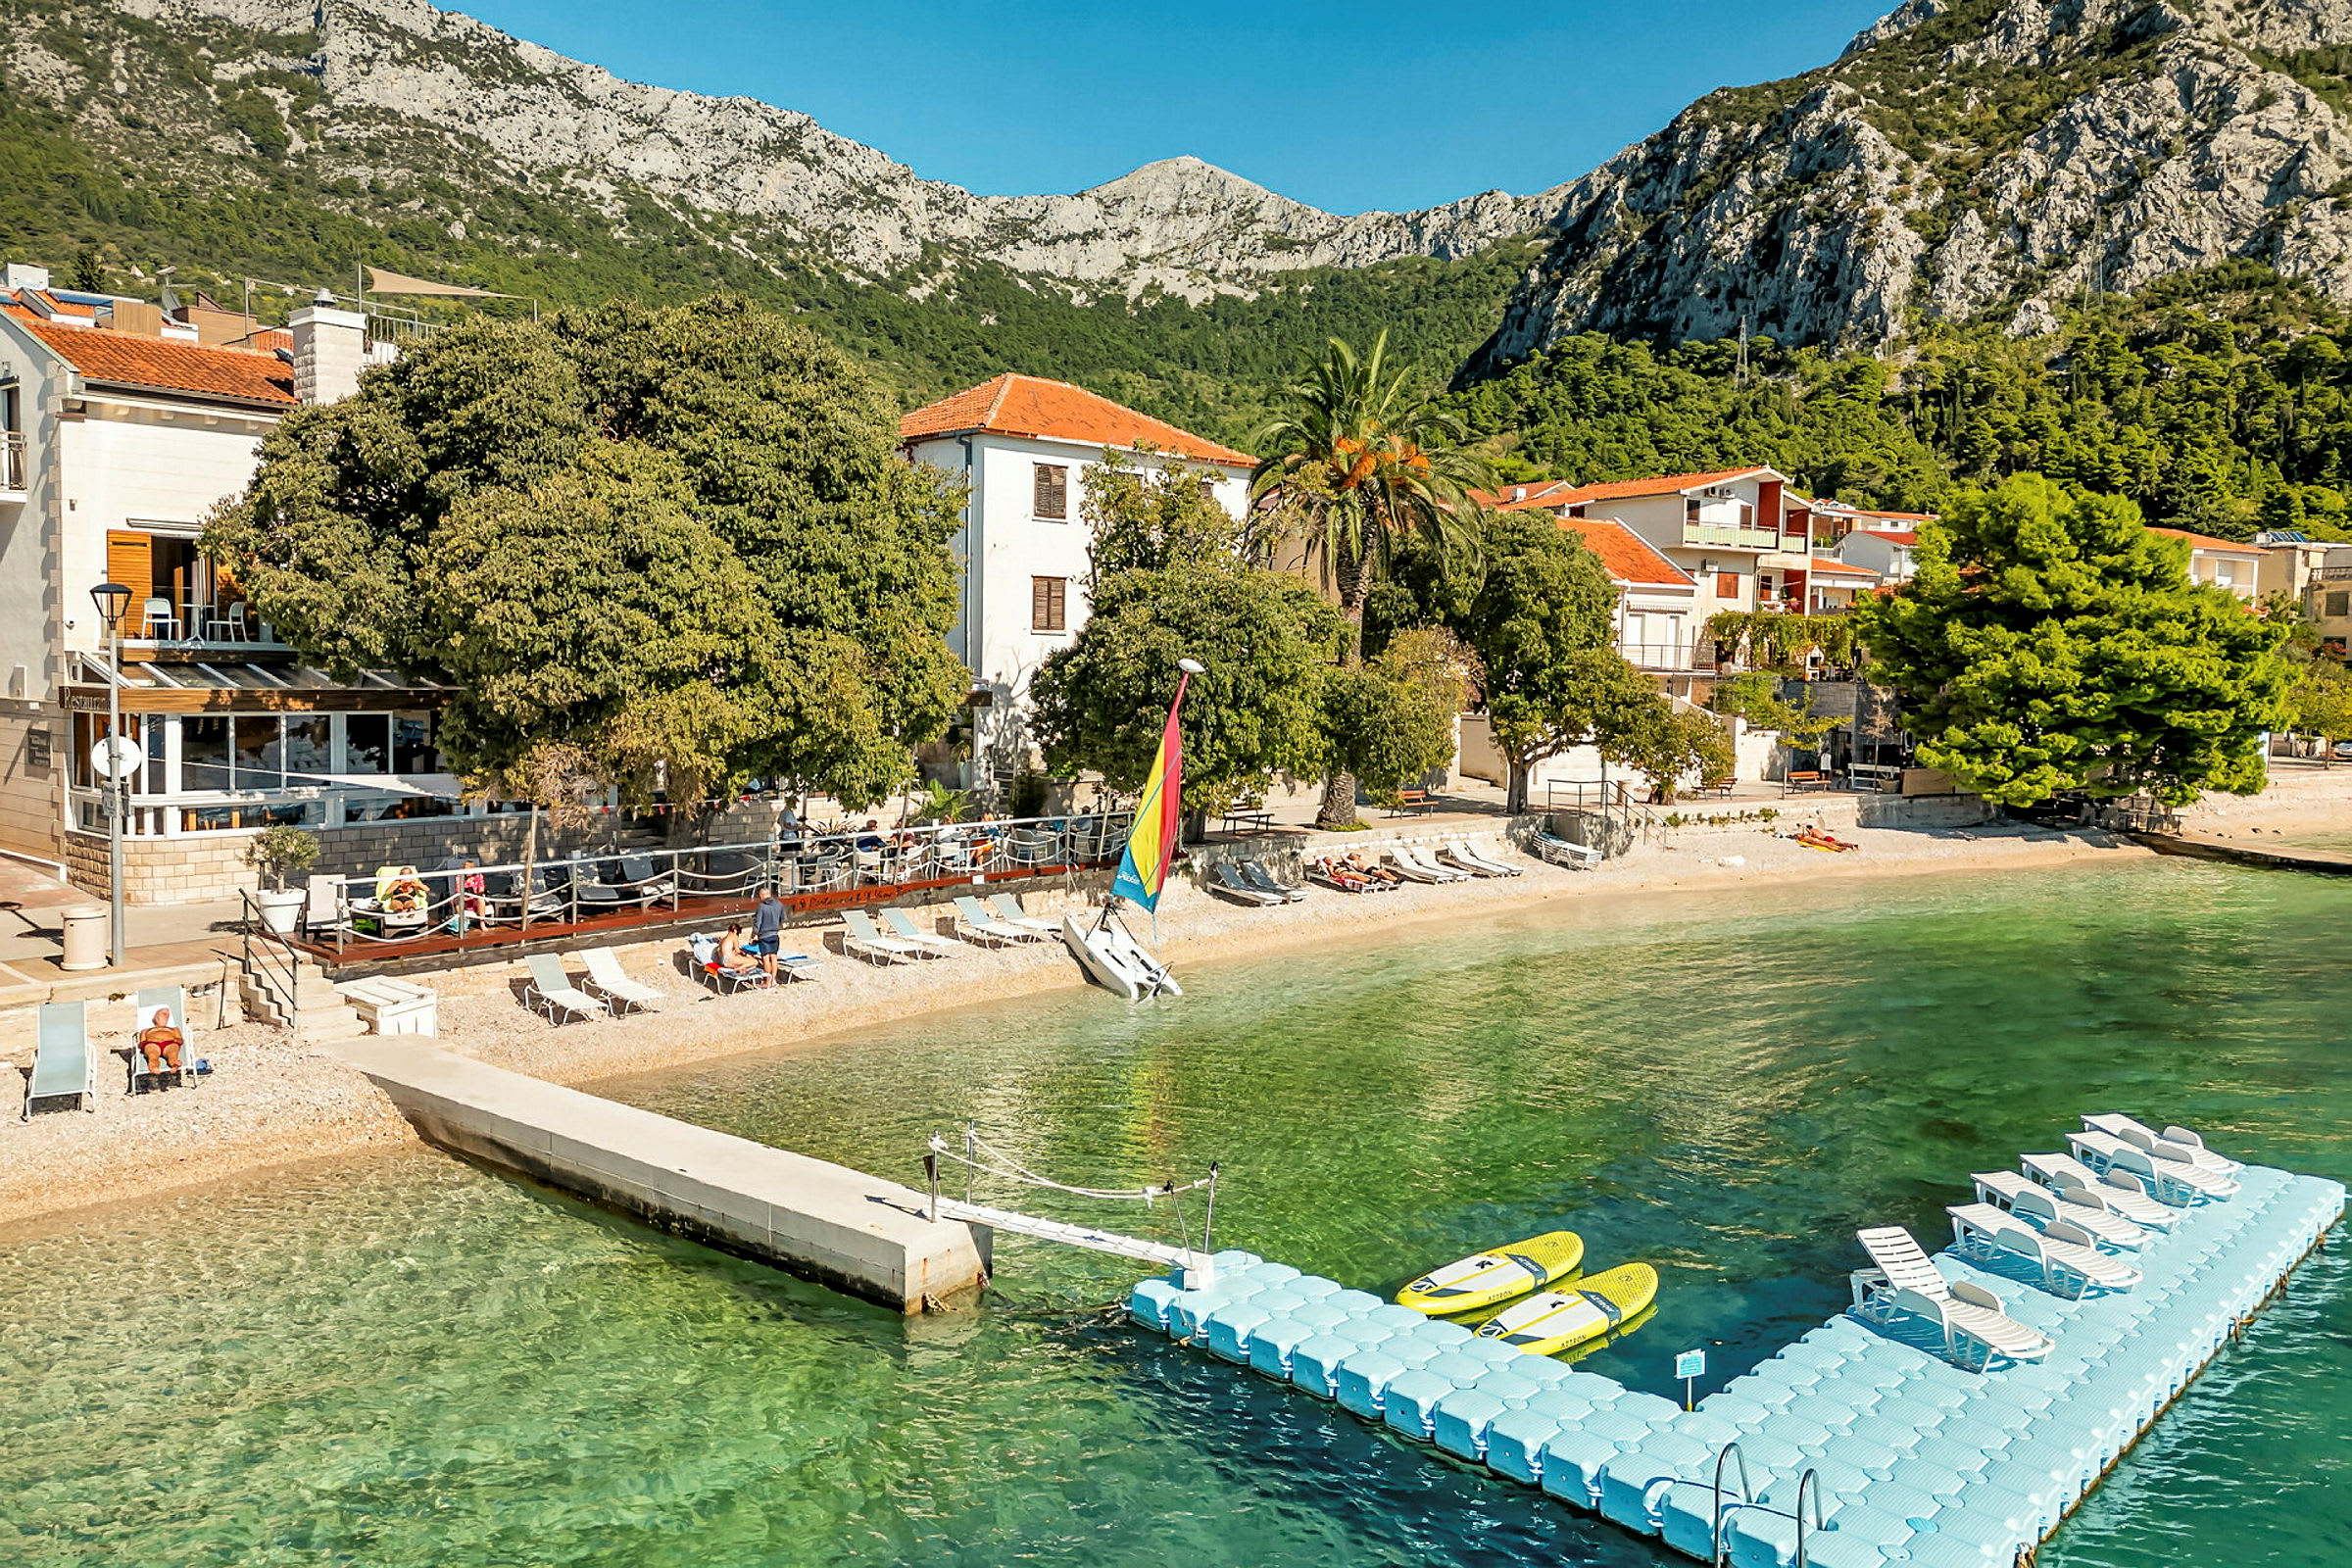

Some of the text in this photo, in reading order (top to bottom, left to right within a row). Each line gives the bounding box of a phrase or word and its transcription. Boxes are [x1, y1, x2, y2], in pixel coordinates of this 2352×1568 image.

[1488, 1290, 1513, 1301] AZTRON
[1589, 1294, 1615, 1312] AZTRON
[1561, 1334, 1587, 1349] AZTRON
